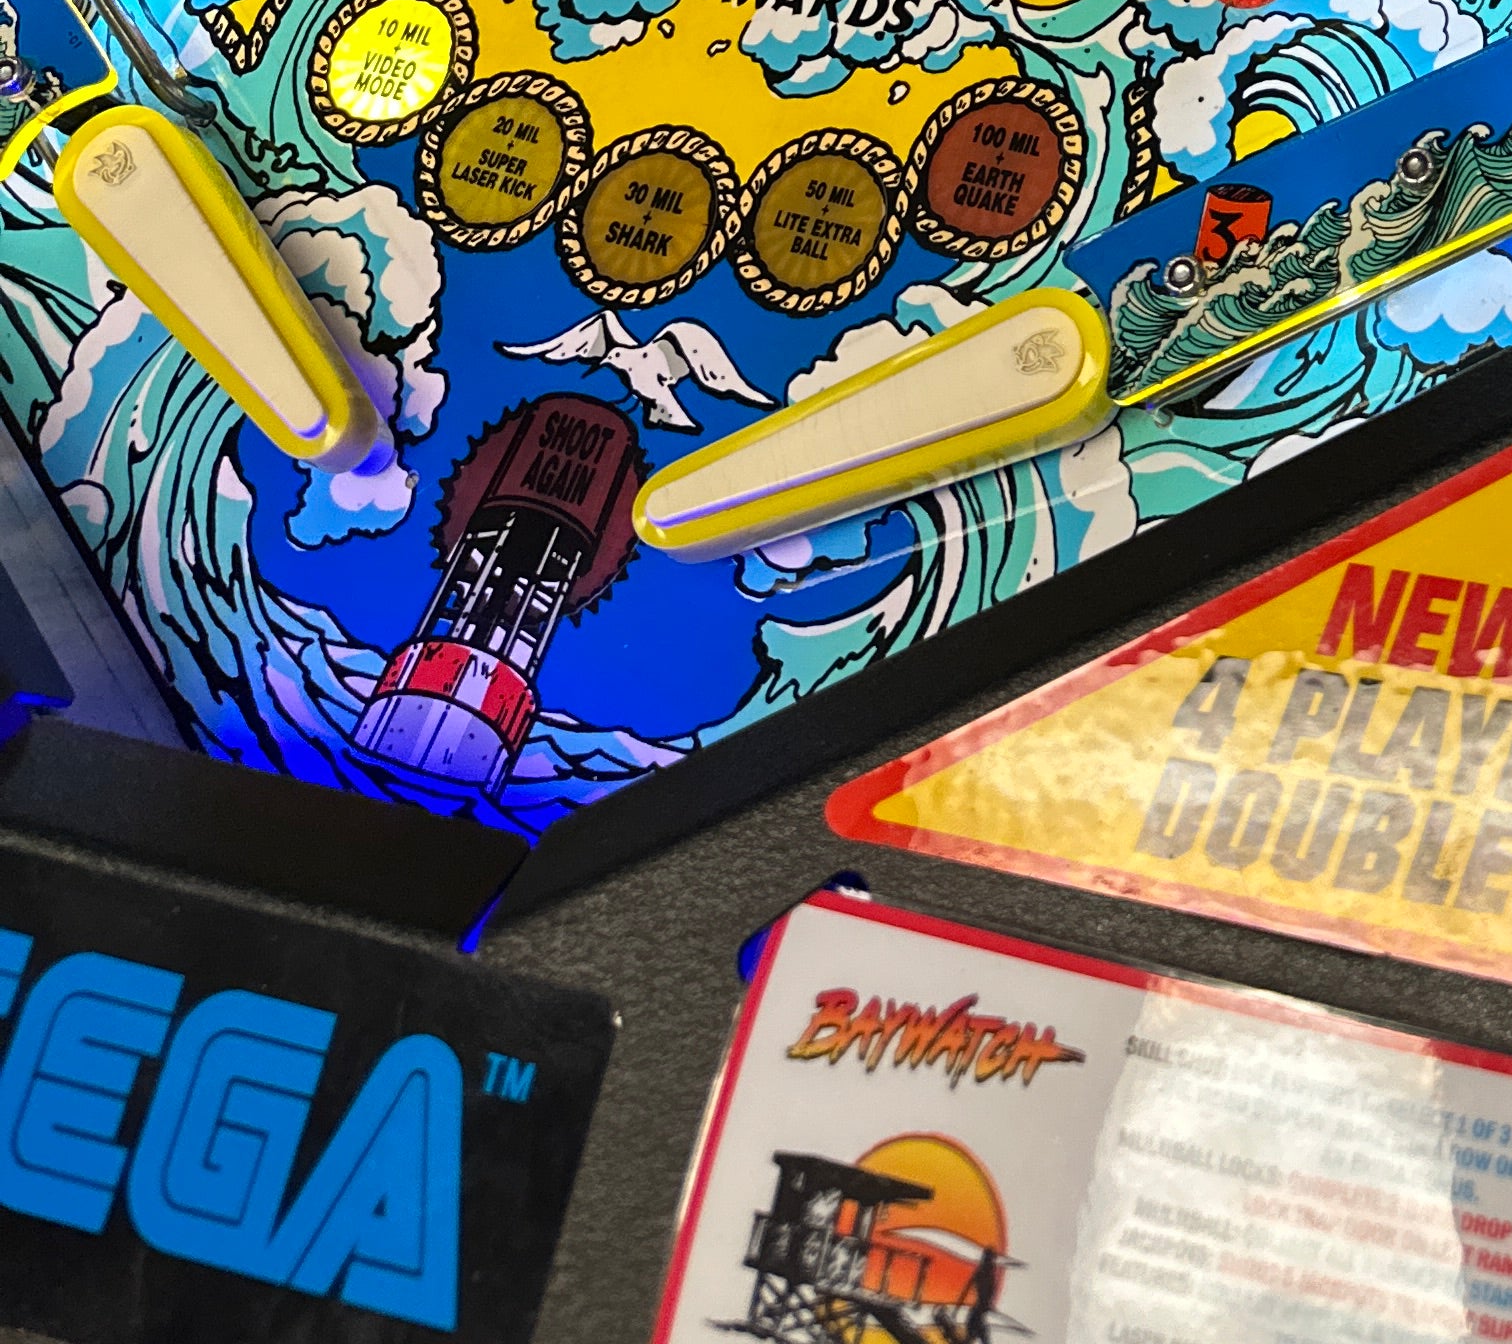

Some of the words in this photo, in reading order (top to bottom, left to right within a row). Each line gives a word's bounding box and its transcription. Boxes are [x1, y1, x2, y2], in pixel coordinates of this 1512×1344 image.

[377, 17, 399, 39] 10
[402, 20, 432, 47] MIL
[362, 51, 417, 82] VIDEO
[354, 72, 408, 102] MODE
[492, 116, 514, 135] 20
[515, 121, 540, 145] MIL
[972, 122, 1006, 149] 100
[1009, 130, 1041, 157] MIL
[478, 148, 528, 175] SUPER
[962, 161, 1026, 194] EARTH
[451, 162, 499, 191] LASER
[499, 173, 538, 202] KICK
[624, 182, 648, 204] 30
[653, 188, 685, 216] MIL
[804, 179, 827, 200] 50
[828, 185, 856, 209] MIL
[953, 184, 1020, 217] QUAKE
[604, 221, 674, 257] SHARK
[773, 210, 811, 234] LITE
[812, 219, 862, 248] EXTRA
[1203, 208, 1244, 267] 3
[790, 237, 829, 262] BALL
[539, 410, 616, 464] SHOOT
[520, 450, 597, 506] AGAIN
[1172, 655, 1253, 755] 4
[786, 988, 1087, 1092] BAYWATCH
[0, 928, 463, 1333] EGA
[484, 1052, 537, 1104] TM
[1471, 1116, 1498, 1141] OF
[1501, 1123, 1512, 1148] 3
